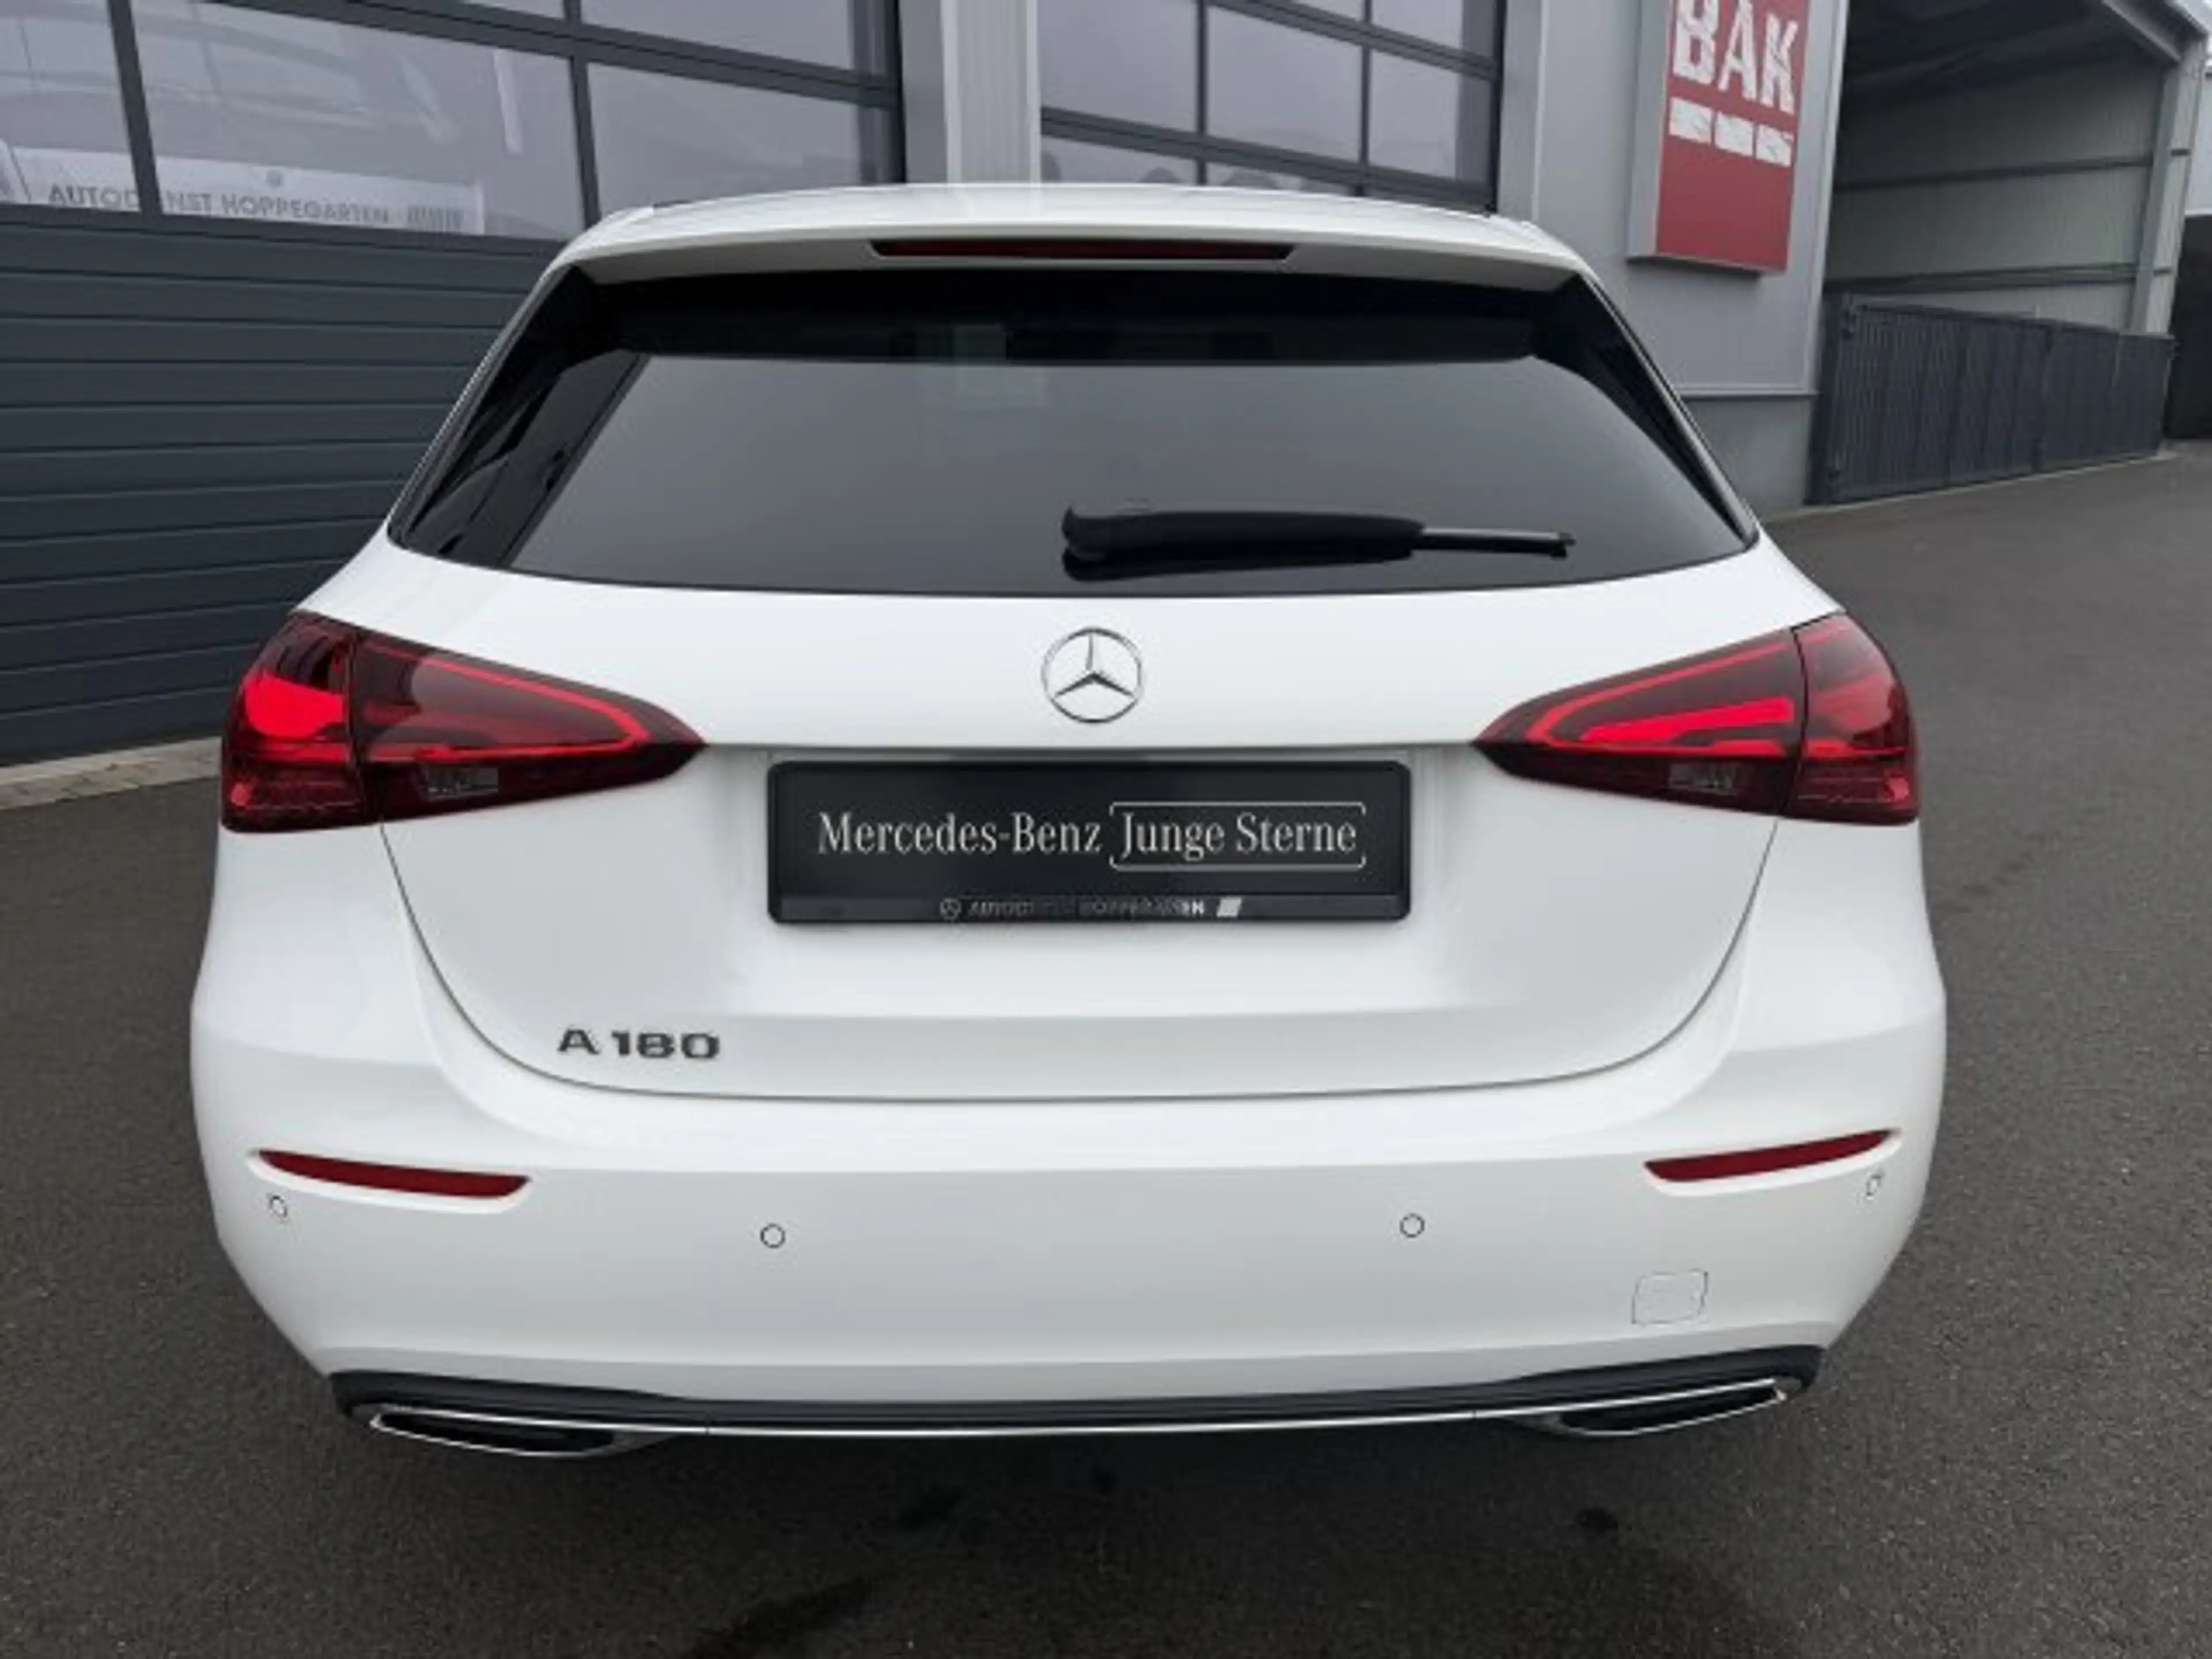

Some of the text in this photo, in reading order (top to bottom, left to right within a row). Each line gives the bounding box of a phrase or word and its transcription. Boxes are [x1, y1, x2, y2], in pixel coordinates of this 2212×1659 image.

[1672, 0, 1798, 115] BAK
[48, 183, 211, 215] AUTODNST
[818, 811, 1357, 862] Mercedes-Benz Junge Sterne
[558, 1029, 720, 1059] A 180
